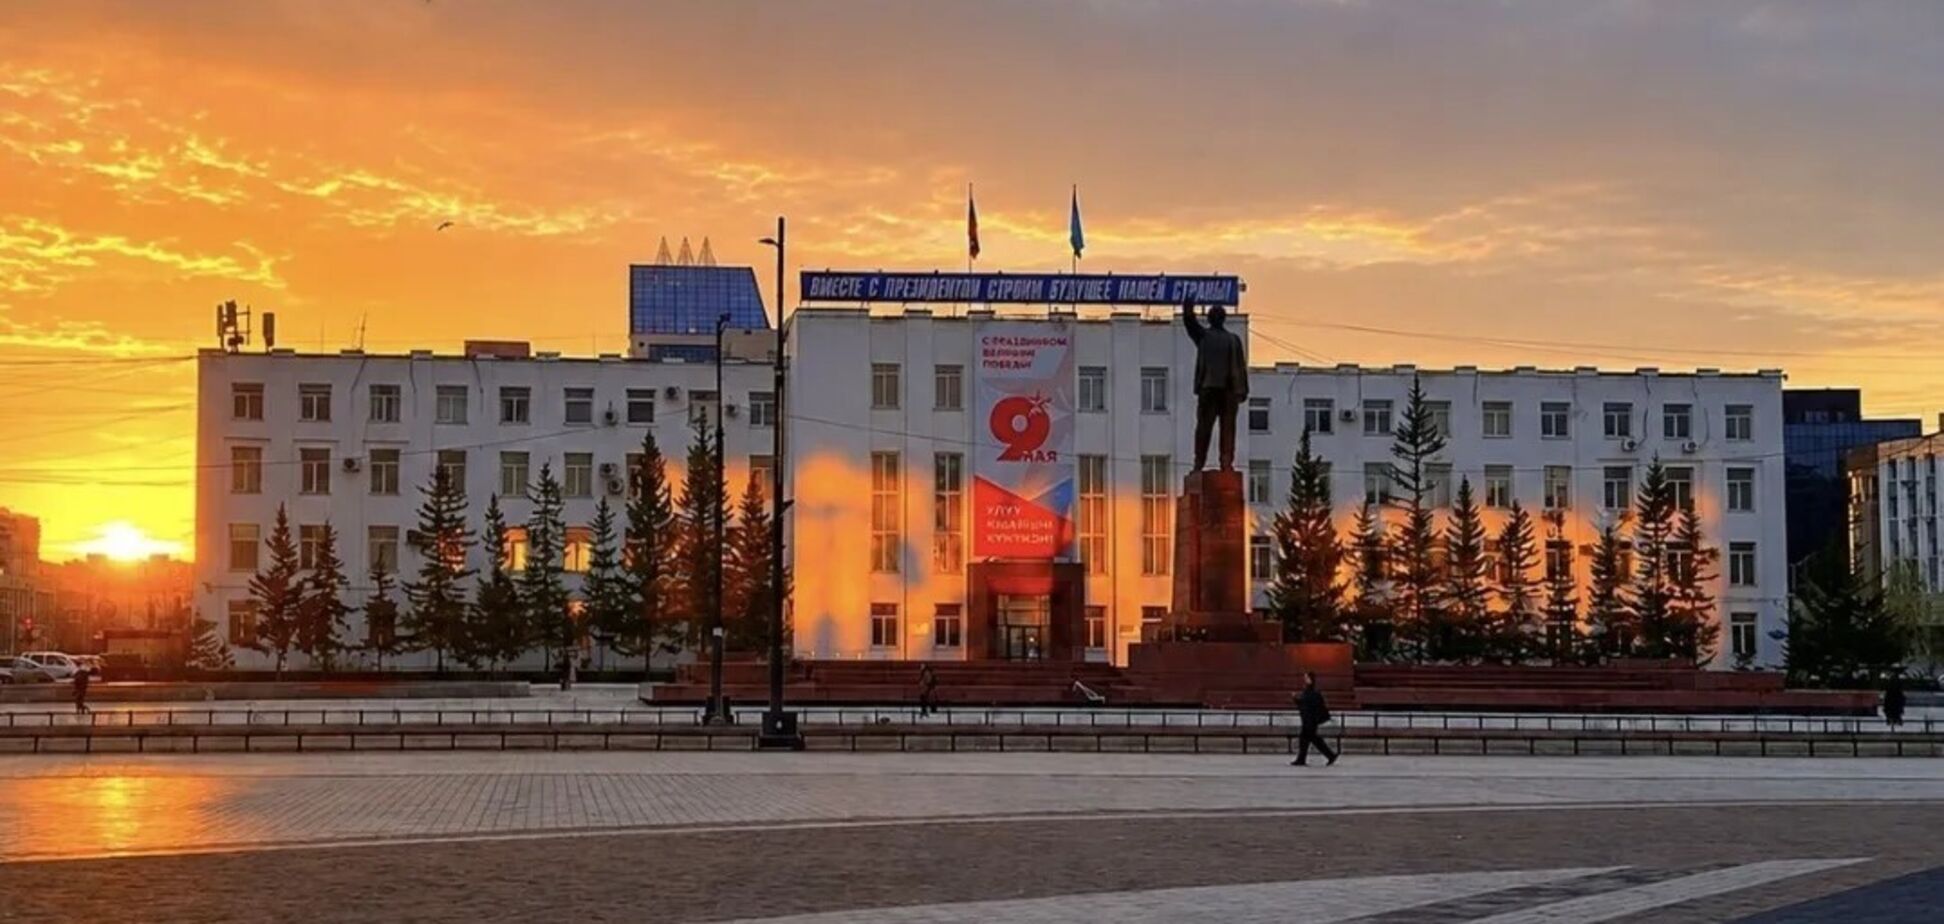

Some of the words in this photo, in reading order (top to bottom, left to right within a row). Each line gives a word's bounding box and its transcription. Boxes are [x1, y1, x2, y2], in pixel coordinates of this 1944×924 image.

[810, 277, 863, 297] ВМЕСТЕ
[869, 278, 880, 297] С
[884, 278, 981, 299] ПРЕЗИДЕНТОМ
[987, 279, 1043, 299] СТРОИМ
[1049, 279, 1112, 301] БУДУЩЕЕ
[1118, 277, 1165, 300] НАШЕЙ
[982, 336, 989, 346] С
[990, 396, 1050, 461] 9
[1023, 450, 1057, 463] МАЯ
